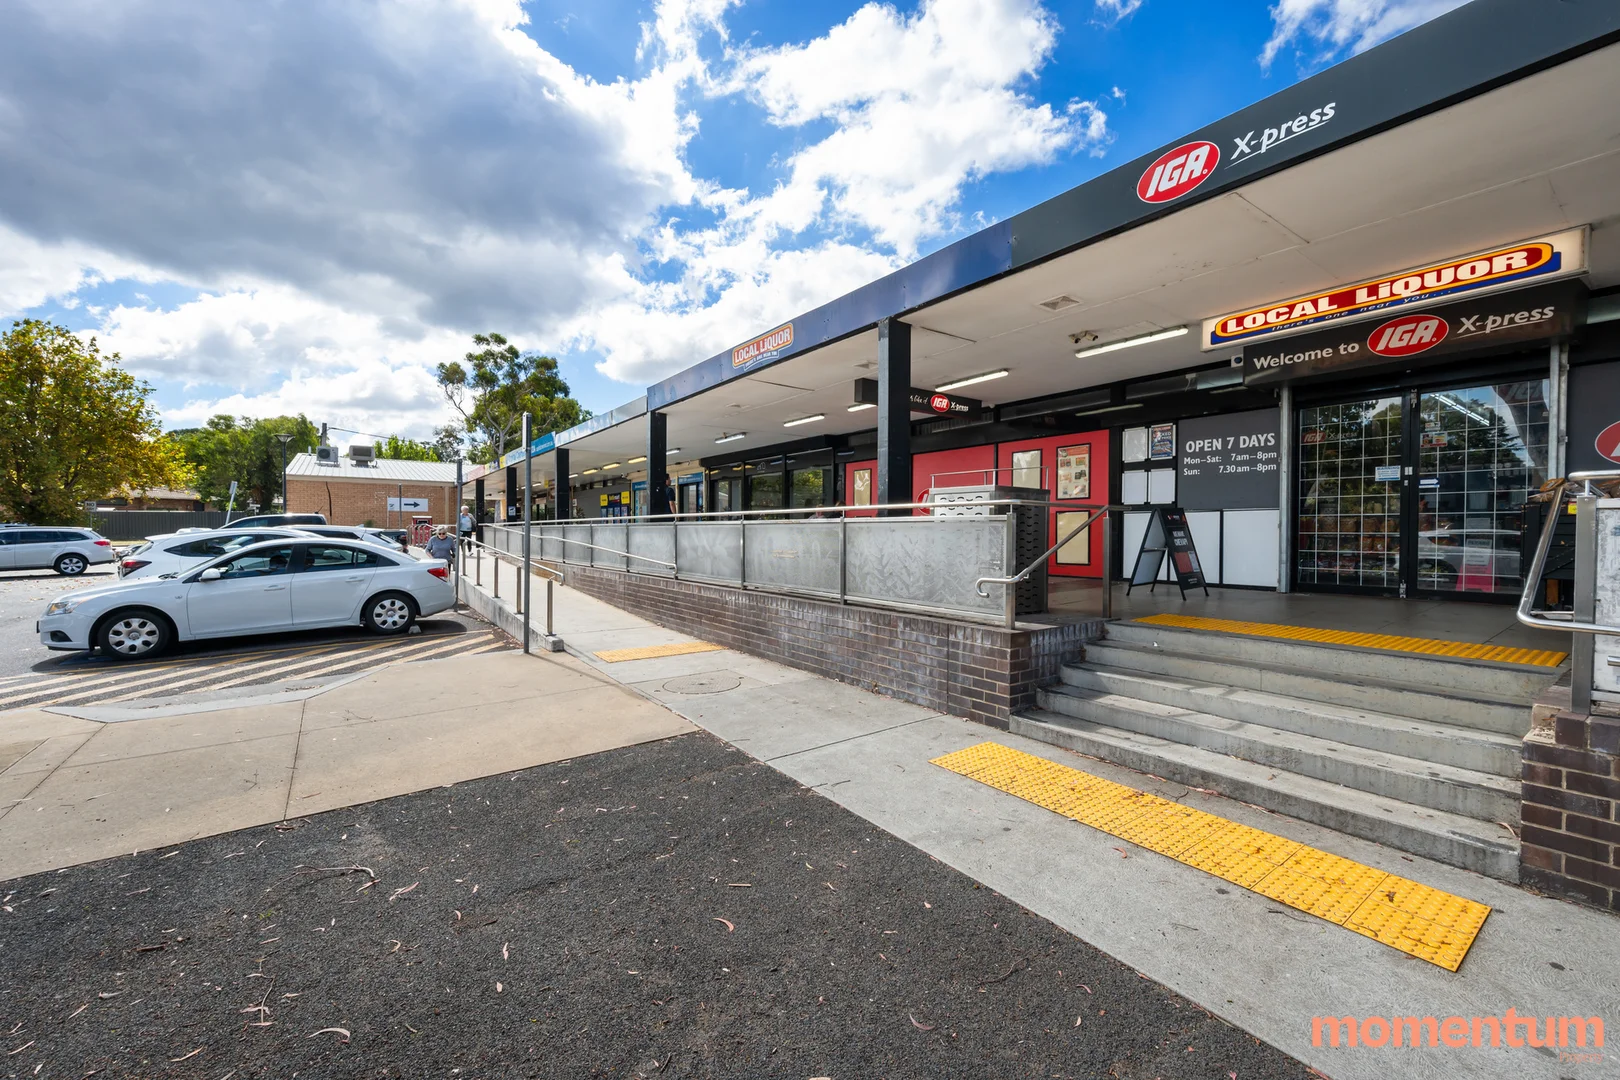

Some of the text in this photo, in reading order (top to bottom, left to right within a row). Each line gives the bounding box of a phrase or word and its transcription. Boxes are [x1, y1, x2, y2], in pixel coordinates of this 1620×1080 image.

[1145, 102, 1337, 199] IGA X-press
[1227, 296, 1338, 333] LOCAL
[1271, 318, 1315, 332] there's
[1325, 311, 1349, 320] one
[1359, 301, 1392, 313] near
[1253, 306, 1555, 370] Welcome to IGA X-press
[734, 342, 759, 363] LOCAL
[933, 397, 948, 409] IGA
[1185, 433, 1275, 453] OPEN 7 DAYS
[1183, 468, 1201, 476] Sun:
